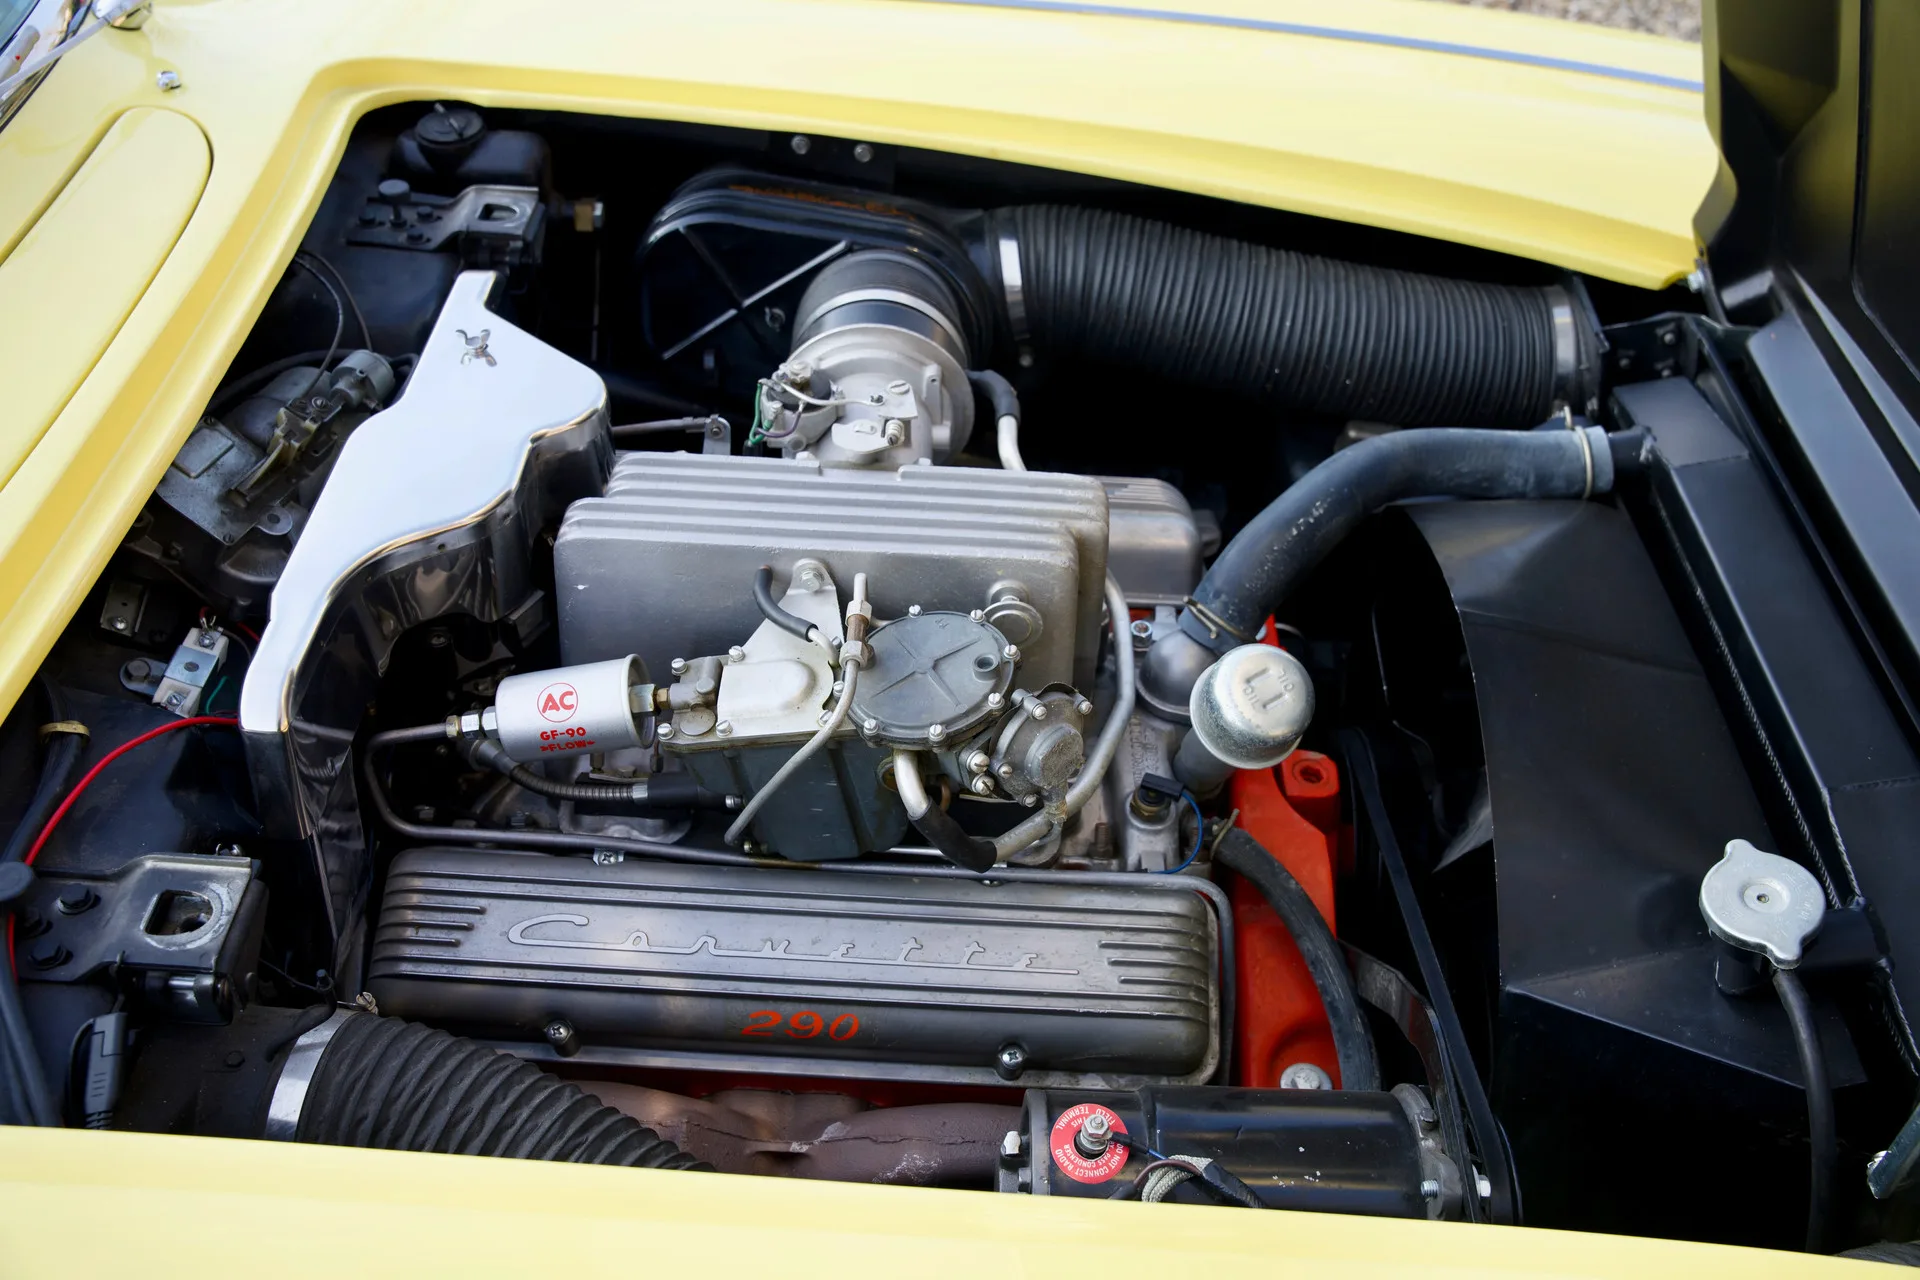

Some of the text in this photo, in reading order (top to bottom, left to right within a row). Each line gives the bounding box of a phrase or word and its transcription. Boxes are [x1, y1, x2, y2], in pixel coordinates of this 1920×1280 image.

[541, 690, 574, 713] AC
[540, 726, 587, 741] GF-90
[740, 1010, 860, 1041] 290
[1056, 1106, 1089, 1129] TERMINAL
[1055, 1148, 1075, 1171] RADIO
[1063, 1143, 1097, 1168] CONDENSER
[1108, 1154, 1120, 1170] NOT
[1075, 1165, 1109, 1178] CONNECT
